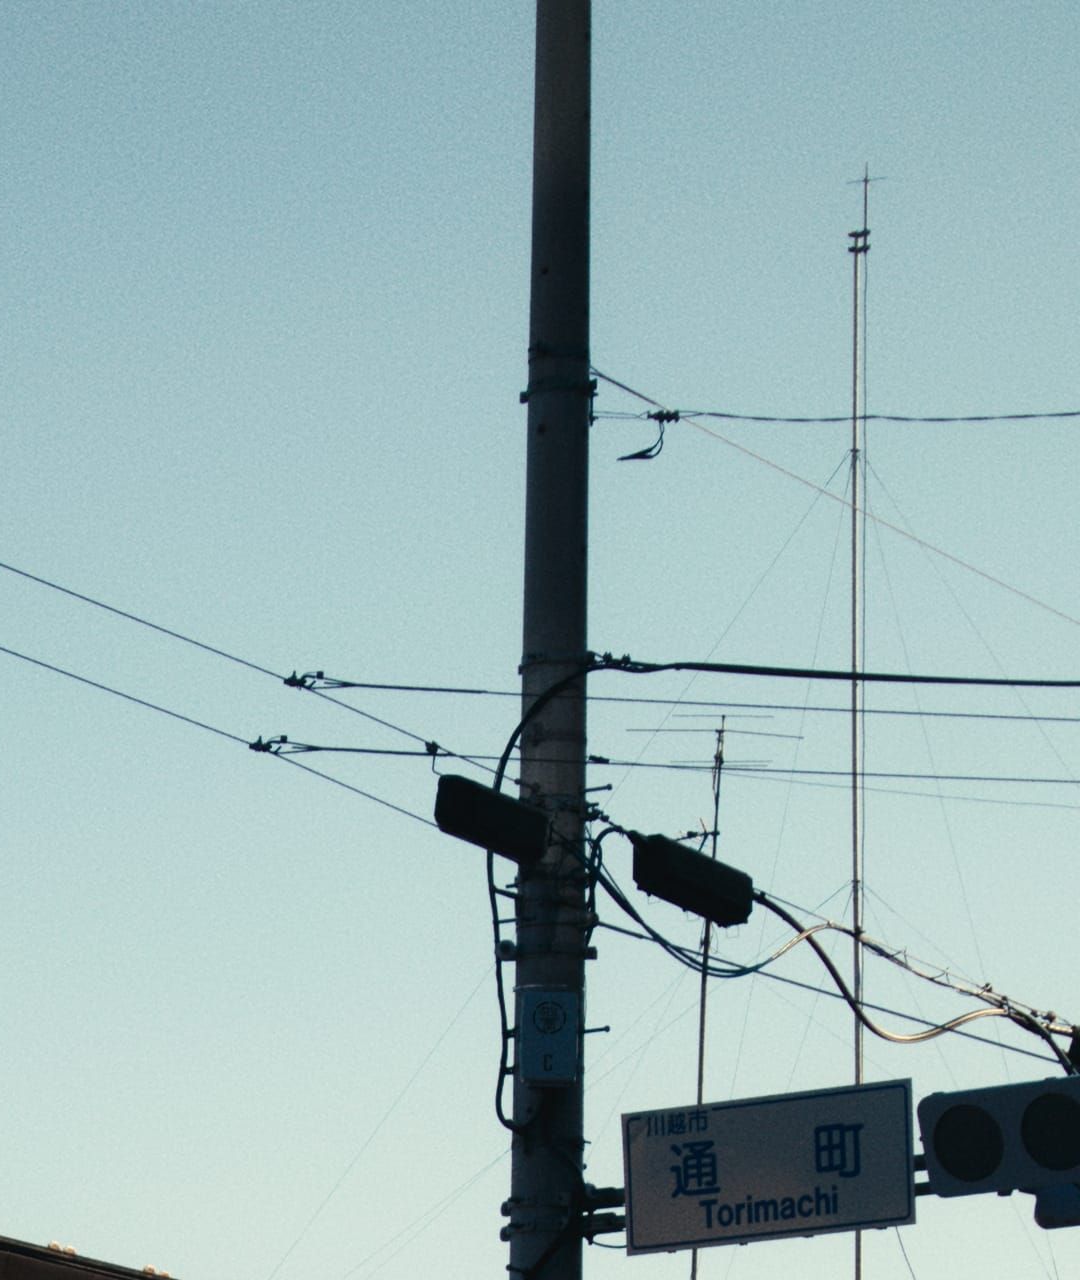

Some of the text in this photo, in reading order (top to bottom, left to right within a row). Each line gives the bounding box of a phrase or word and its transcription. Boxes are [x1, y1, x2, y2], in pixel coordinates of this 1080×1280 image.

[645, 1109, 709, 1137] 川越市
[700, 1185, 838, 1228] Torimachi
